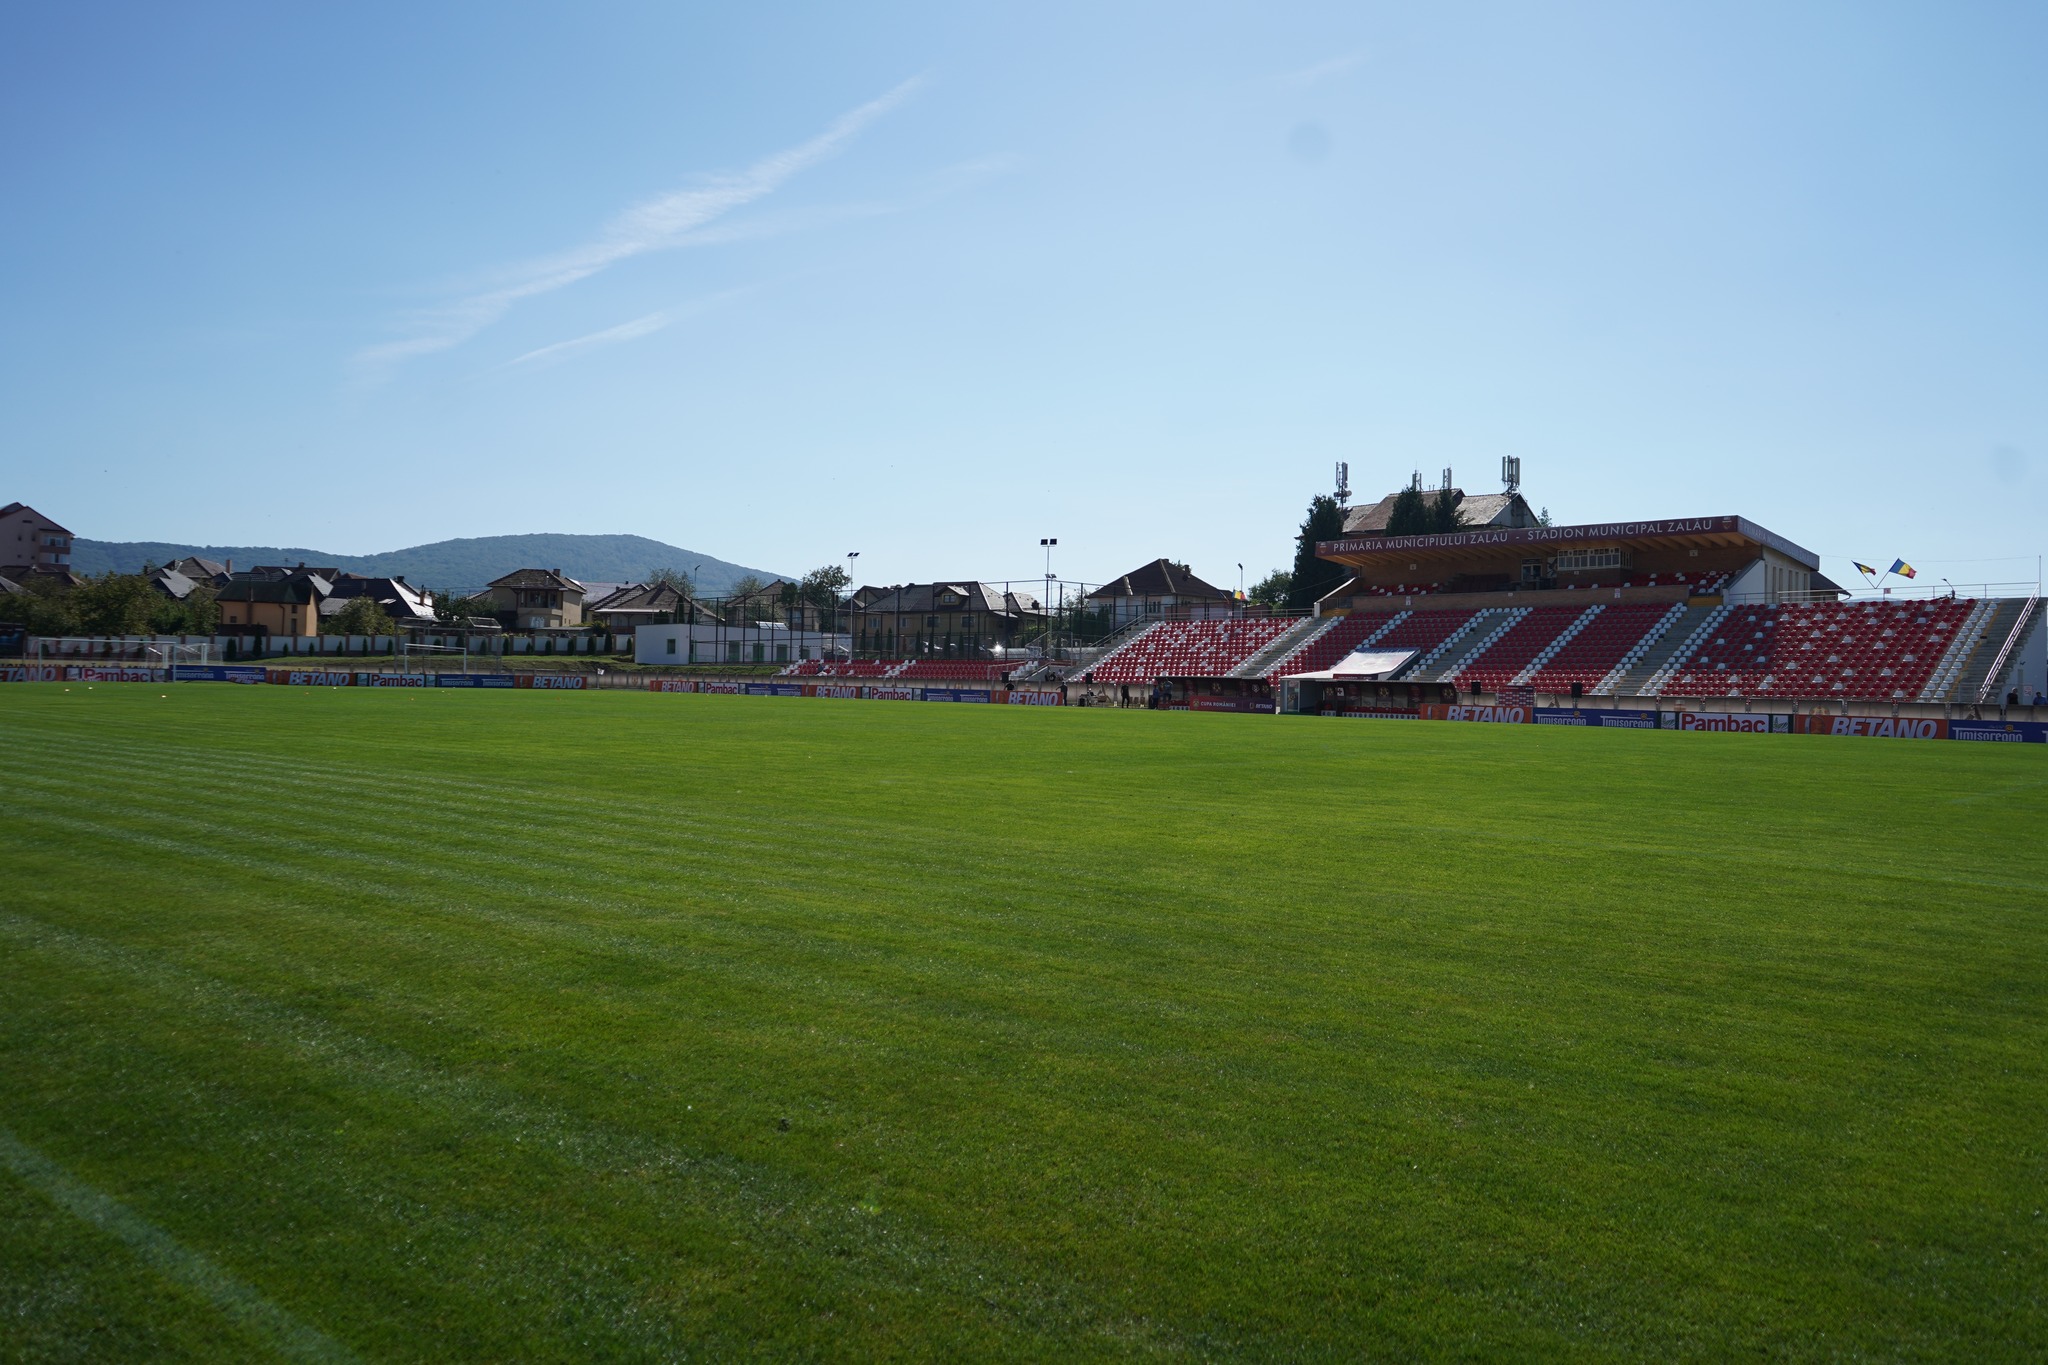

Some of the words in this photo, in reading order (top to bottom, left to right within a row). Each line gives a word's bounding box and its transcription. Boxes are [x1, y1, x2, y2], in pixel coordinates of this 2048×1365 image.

[1386, 535, 1467, 549] MUNICIPIULUI
[1527, 527, 1584, 541] STADION
[1588, 522, 1663, 537] MUNICIPAL
[83, 668, 149, 682] Pambac
[288, 671, 350, 687] BETANO
[371, 674, 424, 688] Pambac
[532, 676, 583, 689] BETANO
[661, 681, 695, 693] BETANO
[706, 683, 738, 695] Pambac
[815, 686, 857, 699] BETANO
[871, 687, 911, 701] Pambac
[1008, 691, 1059, 706] BETANO
[1447, 705, 1525, 724] BETANO
[1681, 713, 1766, 734] Pambac
[1830, 716, 1938, 740] BETANO
